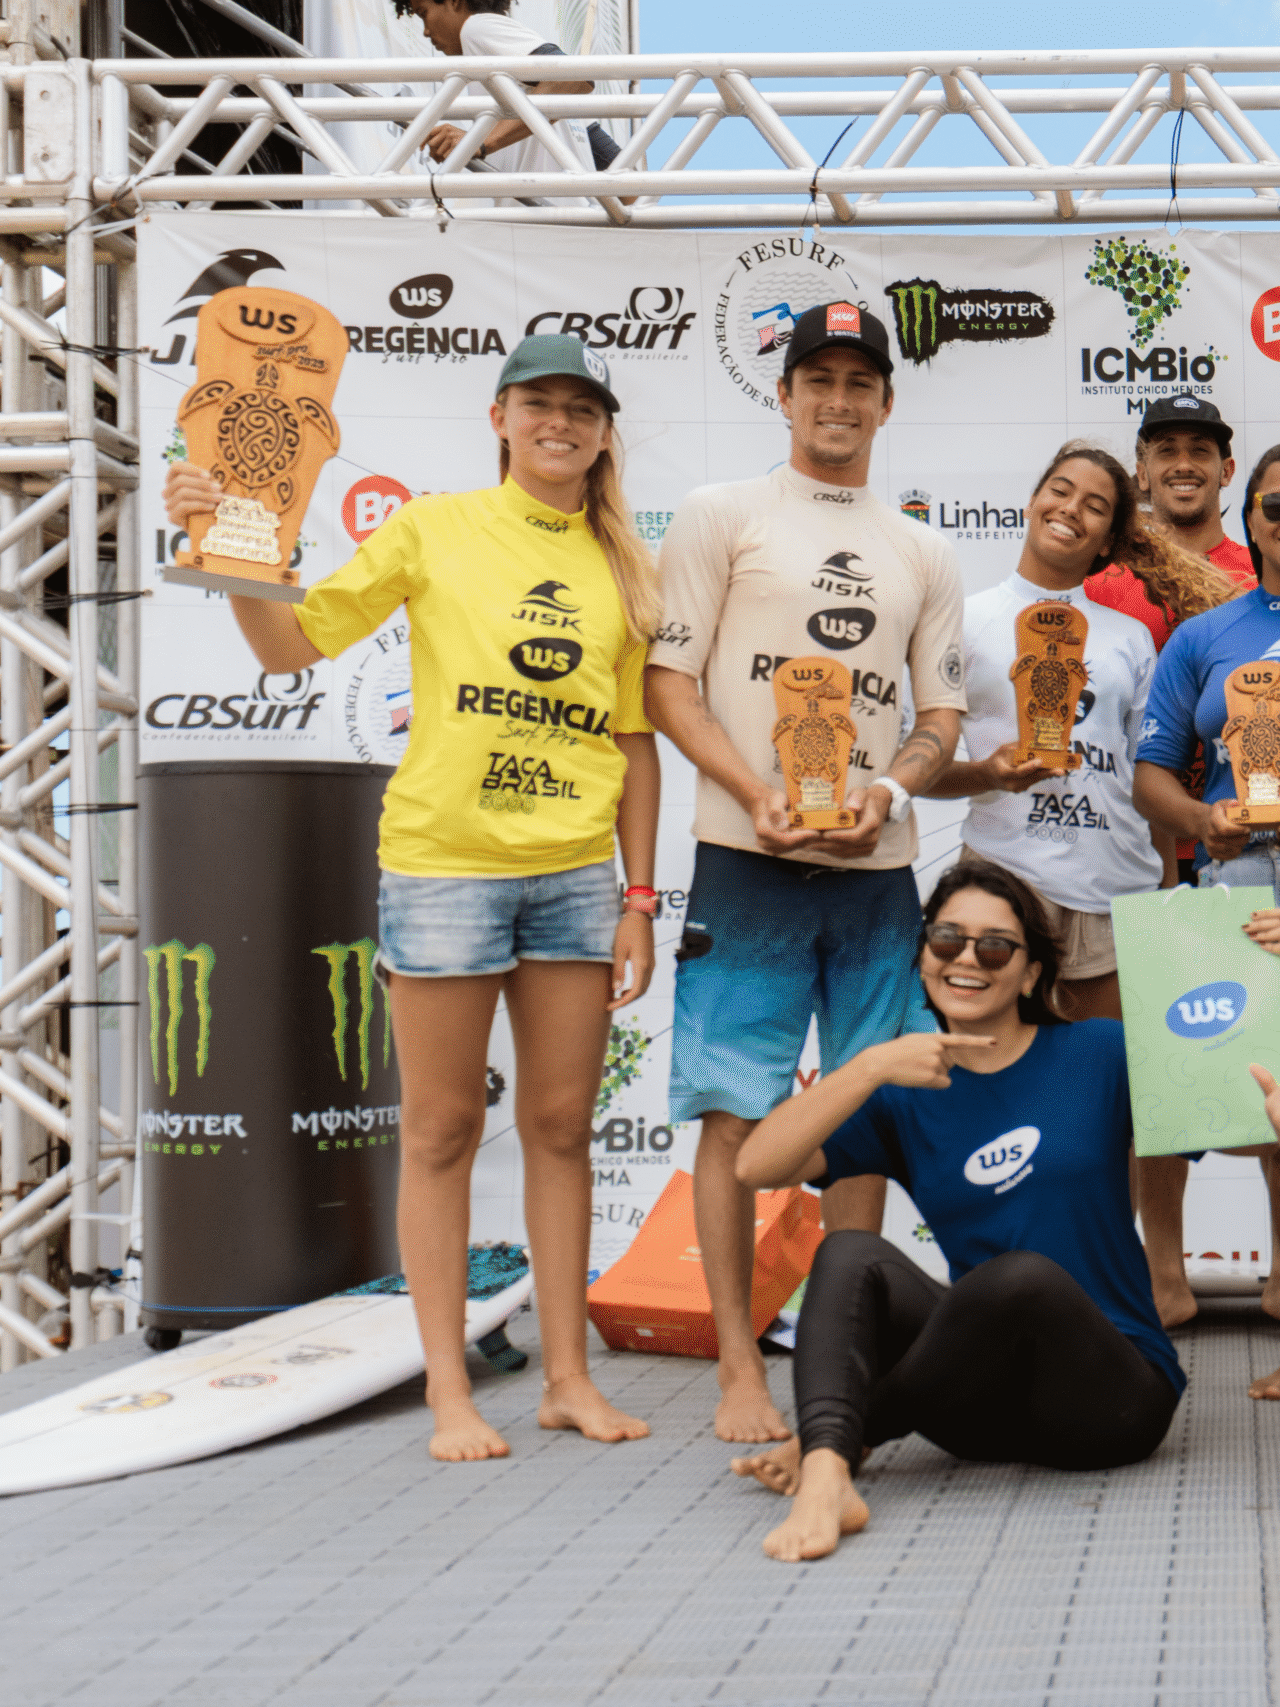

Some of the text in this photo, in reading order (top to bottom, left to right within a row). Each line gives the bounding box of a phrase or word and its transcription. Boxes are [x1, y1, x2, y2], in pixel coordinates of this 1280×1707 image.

[736, 237, 846, 273] FESURF
[941, 300, 1046, 321] MONSTER
[344, 321, 508, 356] REGÊNCIA
[958, 323, 1030, 331] ENERGY
[715, 293, 744, 385] FEDERAÇÃO
[741, 382, 762, 401] DE
[1081, 346, 1216, 383] ICMBio
[1081, 385, 1214, 395] INSTITUTO CHICO MENDES
[940, 501, 1025, 529] Linhar
[957, 531, 1024, 540] PREFEITU
[812, 577, 878, 604] JISK
[511, 608, 585, 636] JISK
[145, 692, 327, 729] CBSurf
[456, 684, 614, 740] REGÊNCIA
